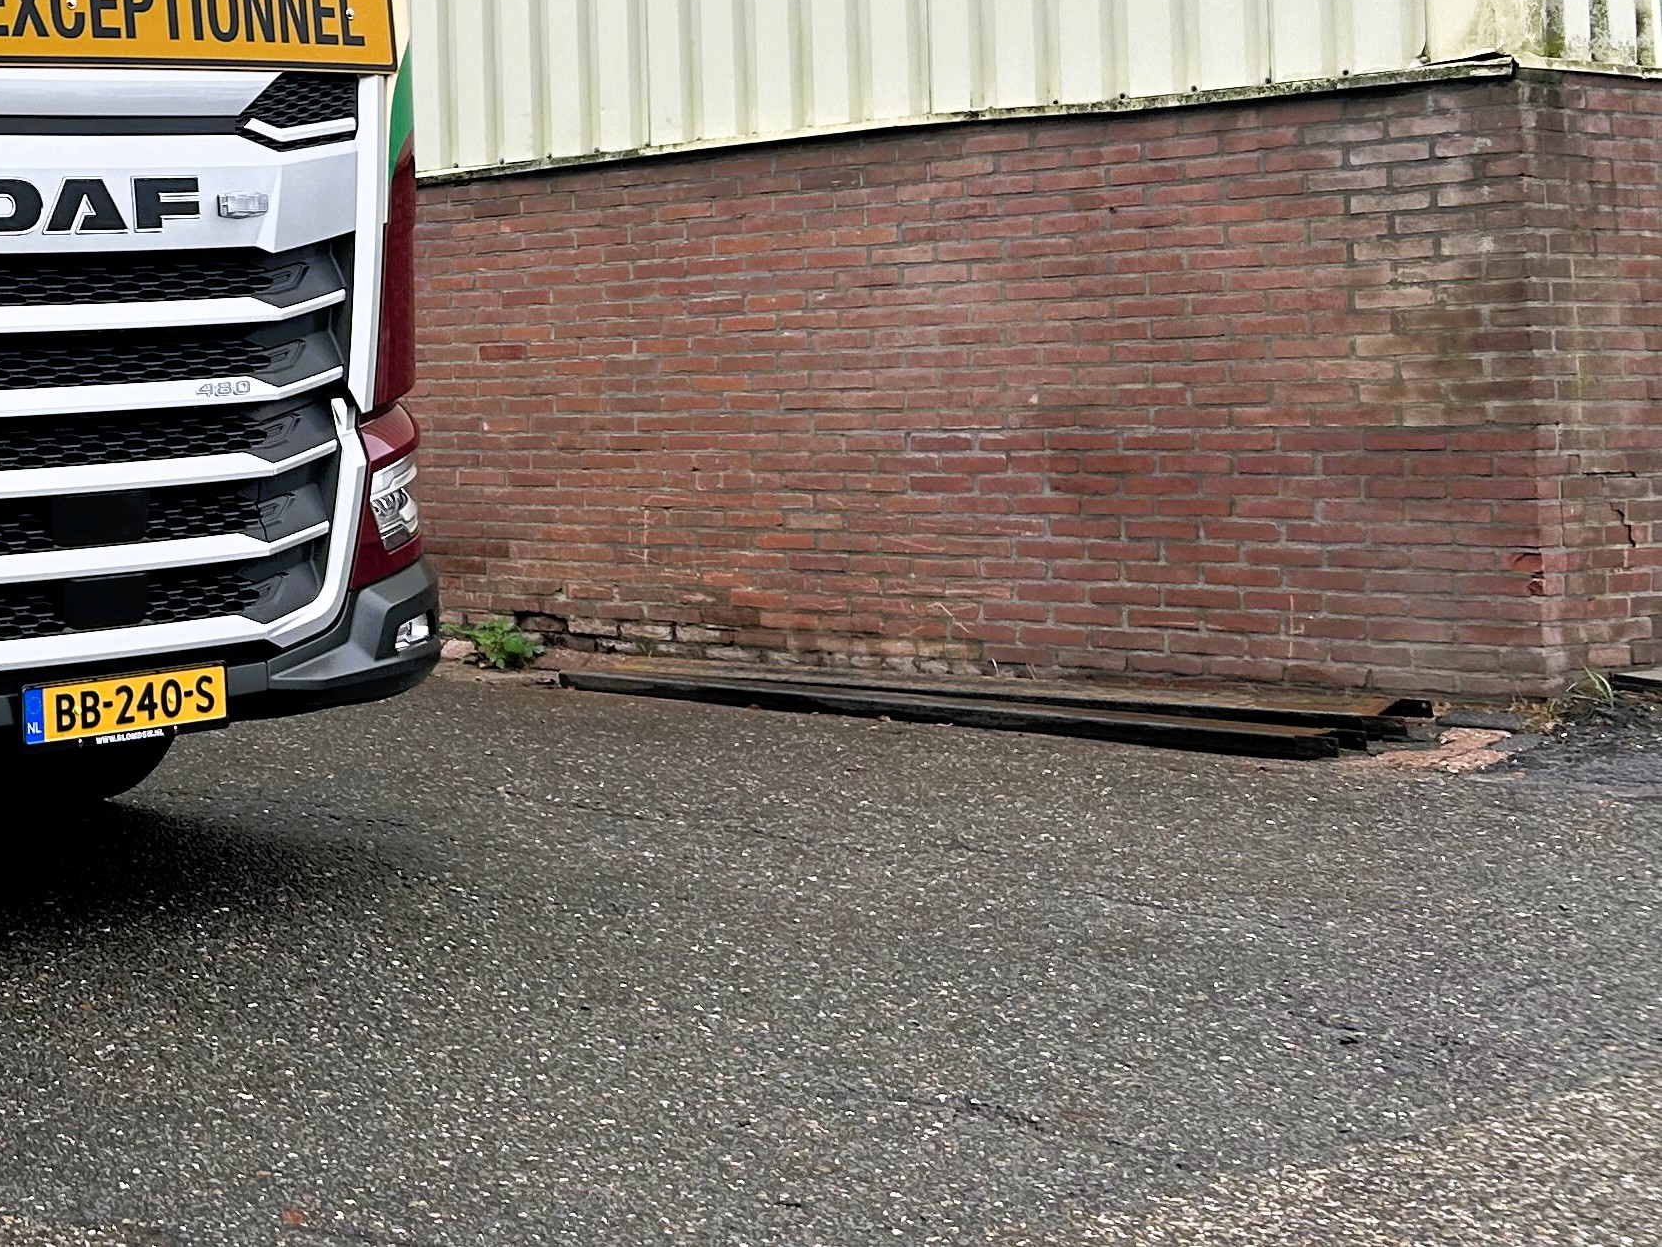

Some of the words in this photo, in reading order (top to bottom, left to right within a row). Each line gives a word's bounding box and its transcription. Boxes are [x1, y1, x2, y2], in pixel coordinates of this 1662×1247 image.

[196, 380, 251, 397] 480
[55, 675, 216, 733] BB-240-S
[27, 721, 43, 734] NL
